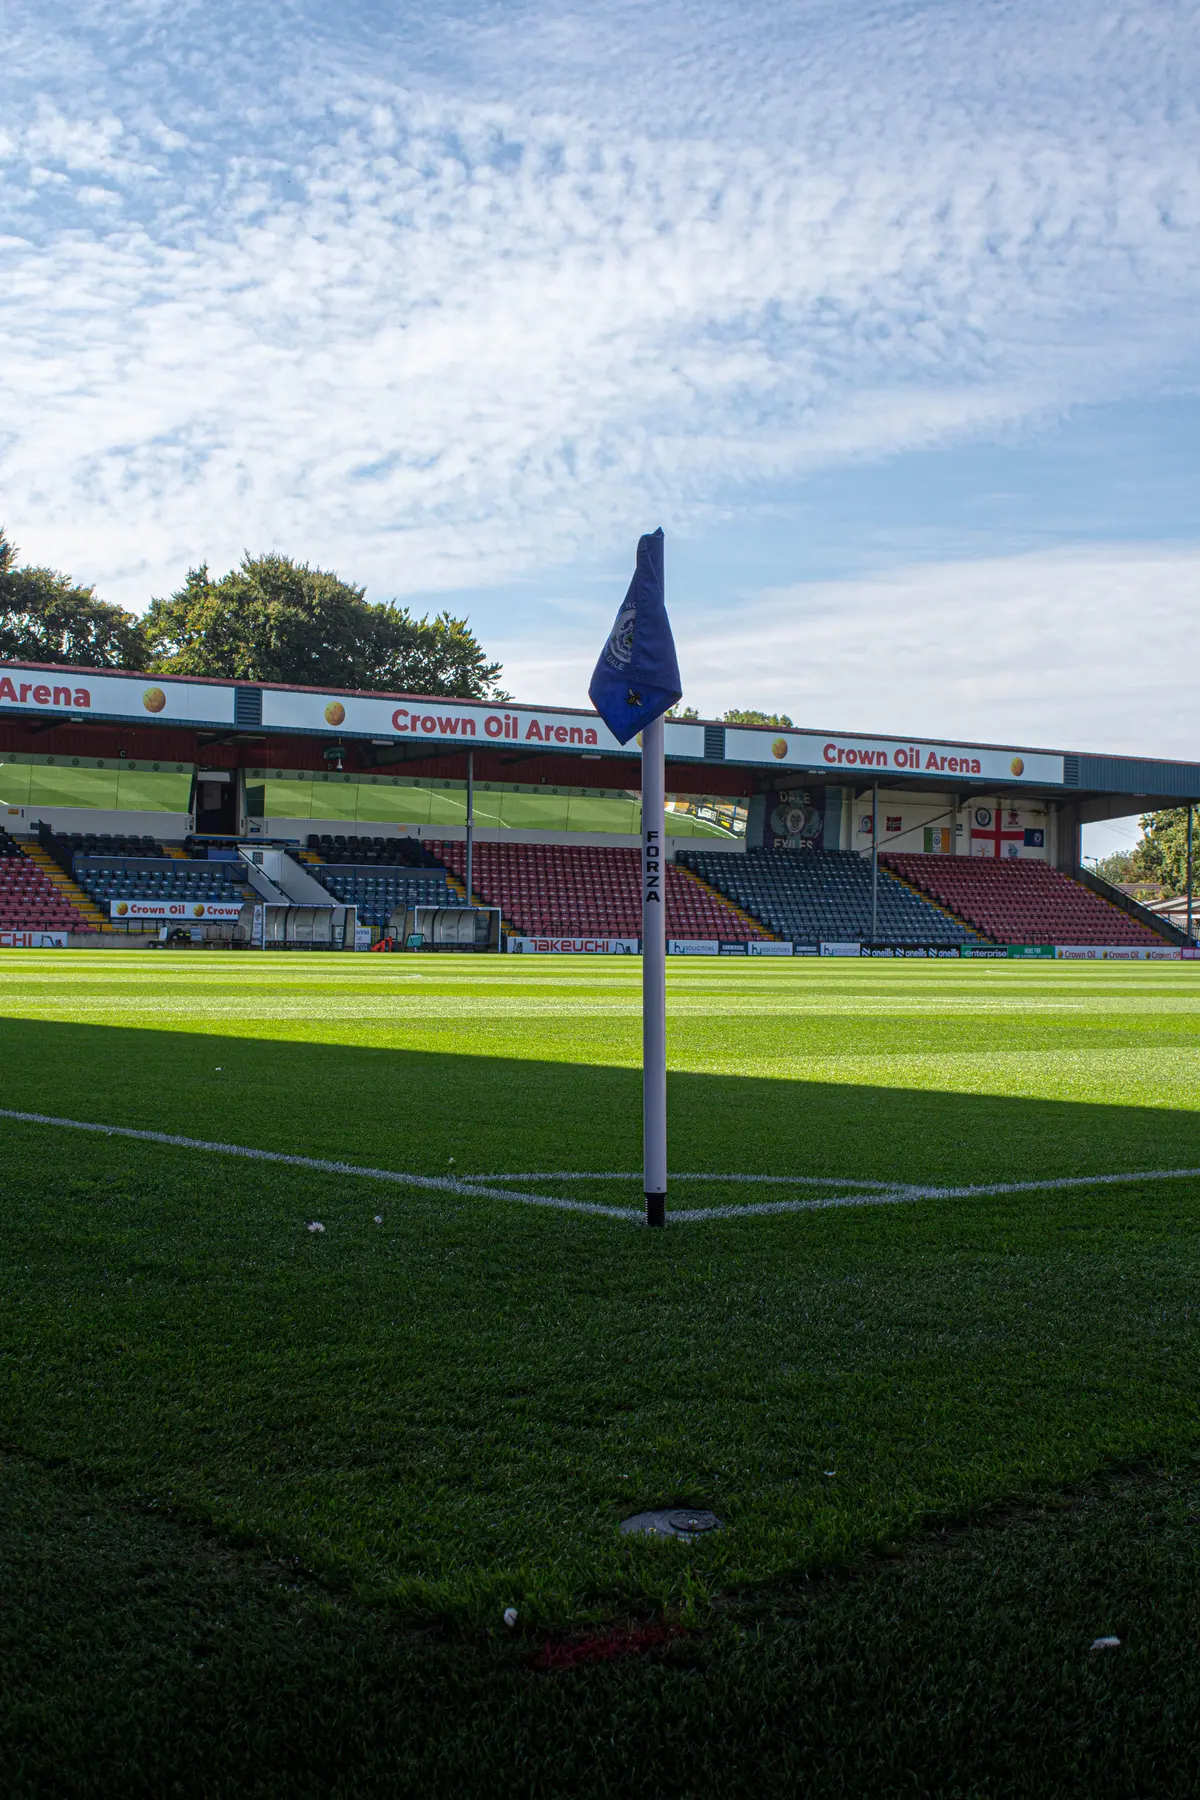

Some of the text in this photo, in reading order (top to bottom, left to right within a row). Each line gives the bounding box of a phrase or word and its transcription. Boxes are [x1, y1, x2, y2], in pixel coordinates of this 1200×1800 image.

[606, 655, 625, 672] DALE
[0, 677, 91, 708] Arena
[391, 709, 598, 745] Crown Oil Arena
[823, 743, 981, 774] Crown Oil Arena
[780, 791, 811, 804] DALE
[773, 838, 814, 851] EXILES
[646, 831, 660, 902] FORZA
[130, 904, 186, 915] Crown Oil
[206, 905, 240, 916] Crown
[0, 932, 32, 947] CHI
[964, 950, 1007, 958] enterprise
[1064, 950, 1087, 959] Crown
[1108, 951, 1130, 959] Crown
